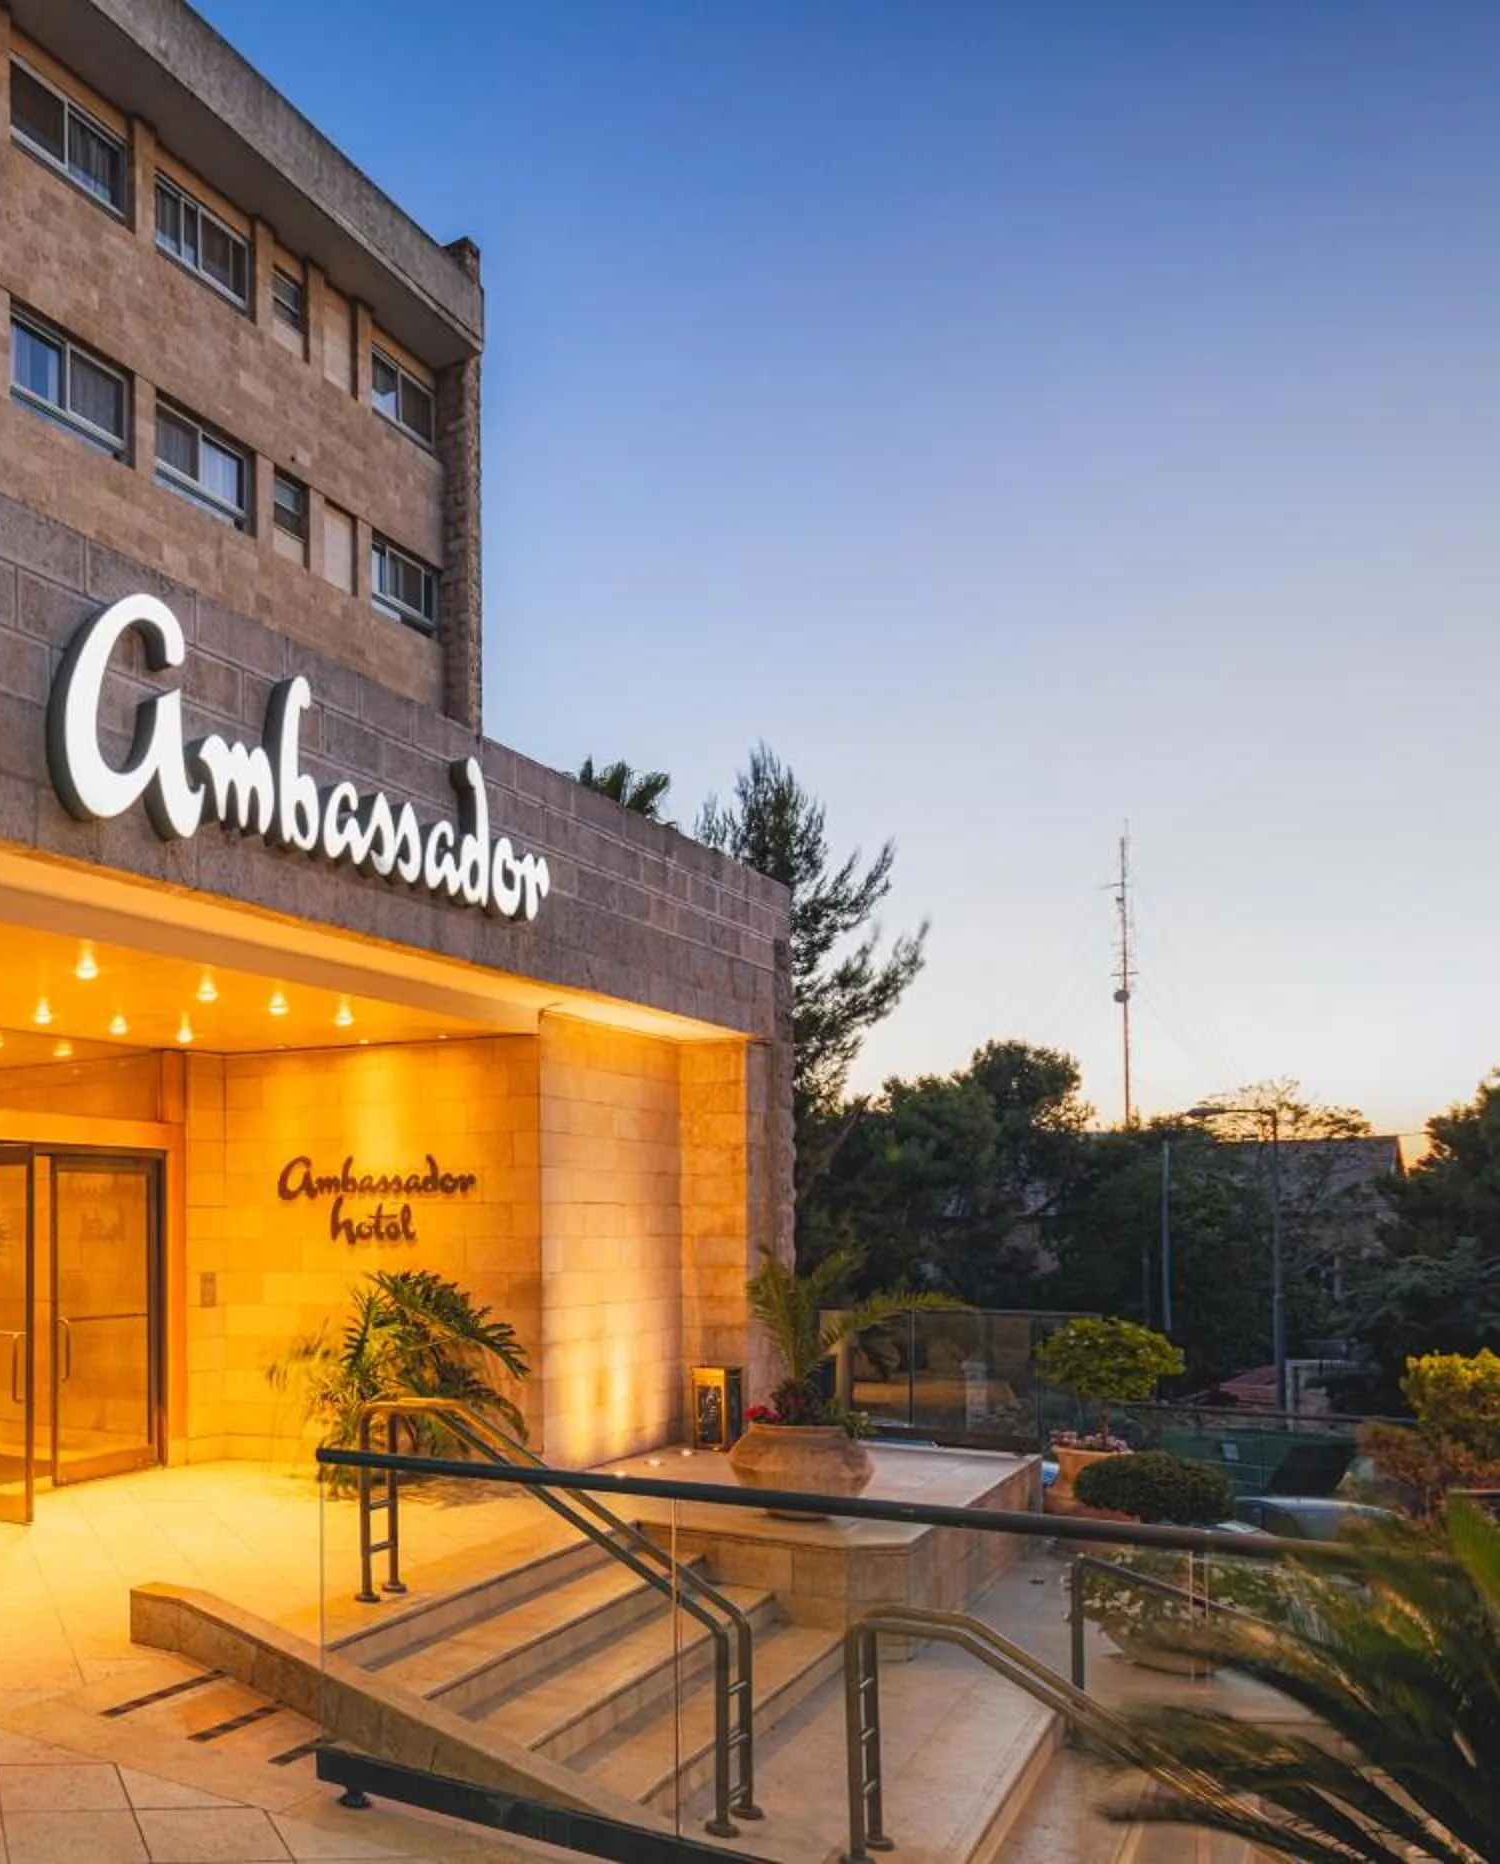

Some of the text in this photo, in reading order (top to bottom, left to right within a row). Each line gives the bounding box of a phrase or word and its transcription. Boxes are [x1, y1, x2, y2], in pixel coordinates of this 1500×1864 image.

[63, 593, 551, 922] Ambassador
[276, 1153, 477, 1201] Ambassador
[330, 1195, 418, 1245] hotel
